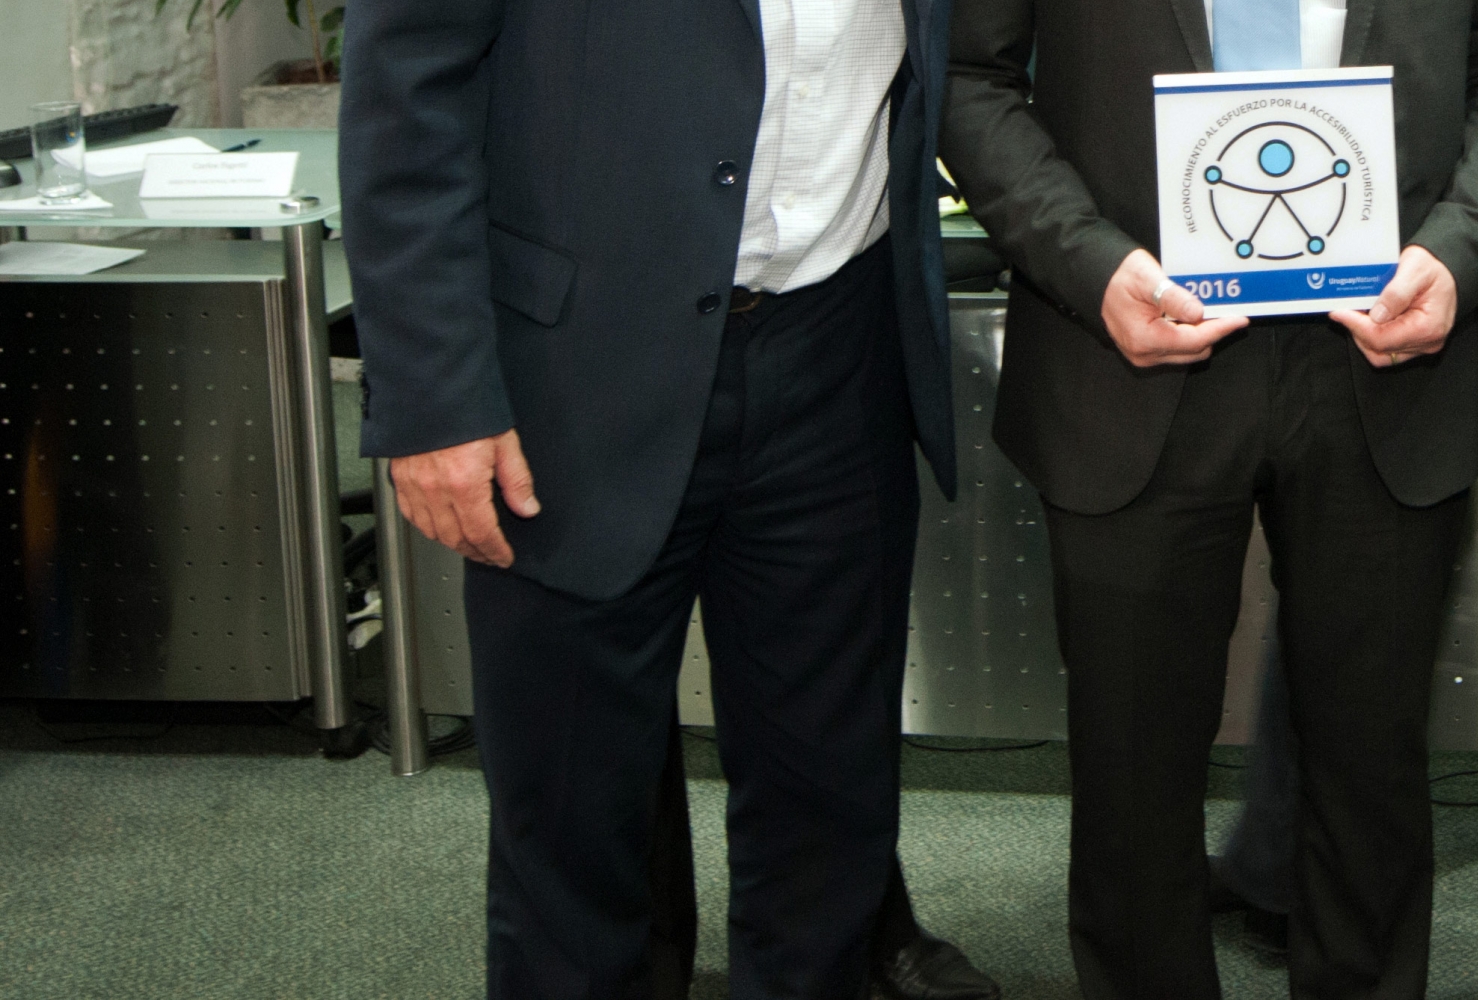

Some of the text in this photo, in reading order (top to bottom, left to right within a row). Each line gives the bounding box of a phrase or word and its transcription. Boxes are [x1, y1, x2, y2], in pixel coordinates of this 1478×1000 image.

[1182, 98, 1375, 233] RECONOCIMIENTO AL ESFUERZO POR LA ACCESIBILIDAD TURÍSTICA
[1185, 278, 1241, 299] 2016
